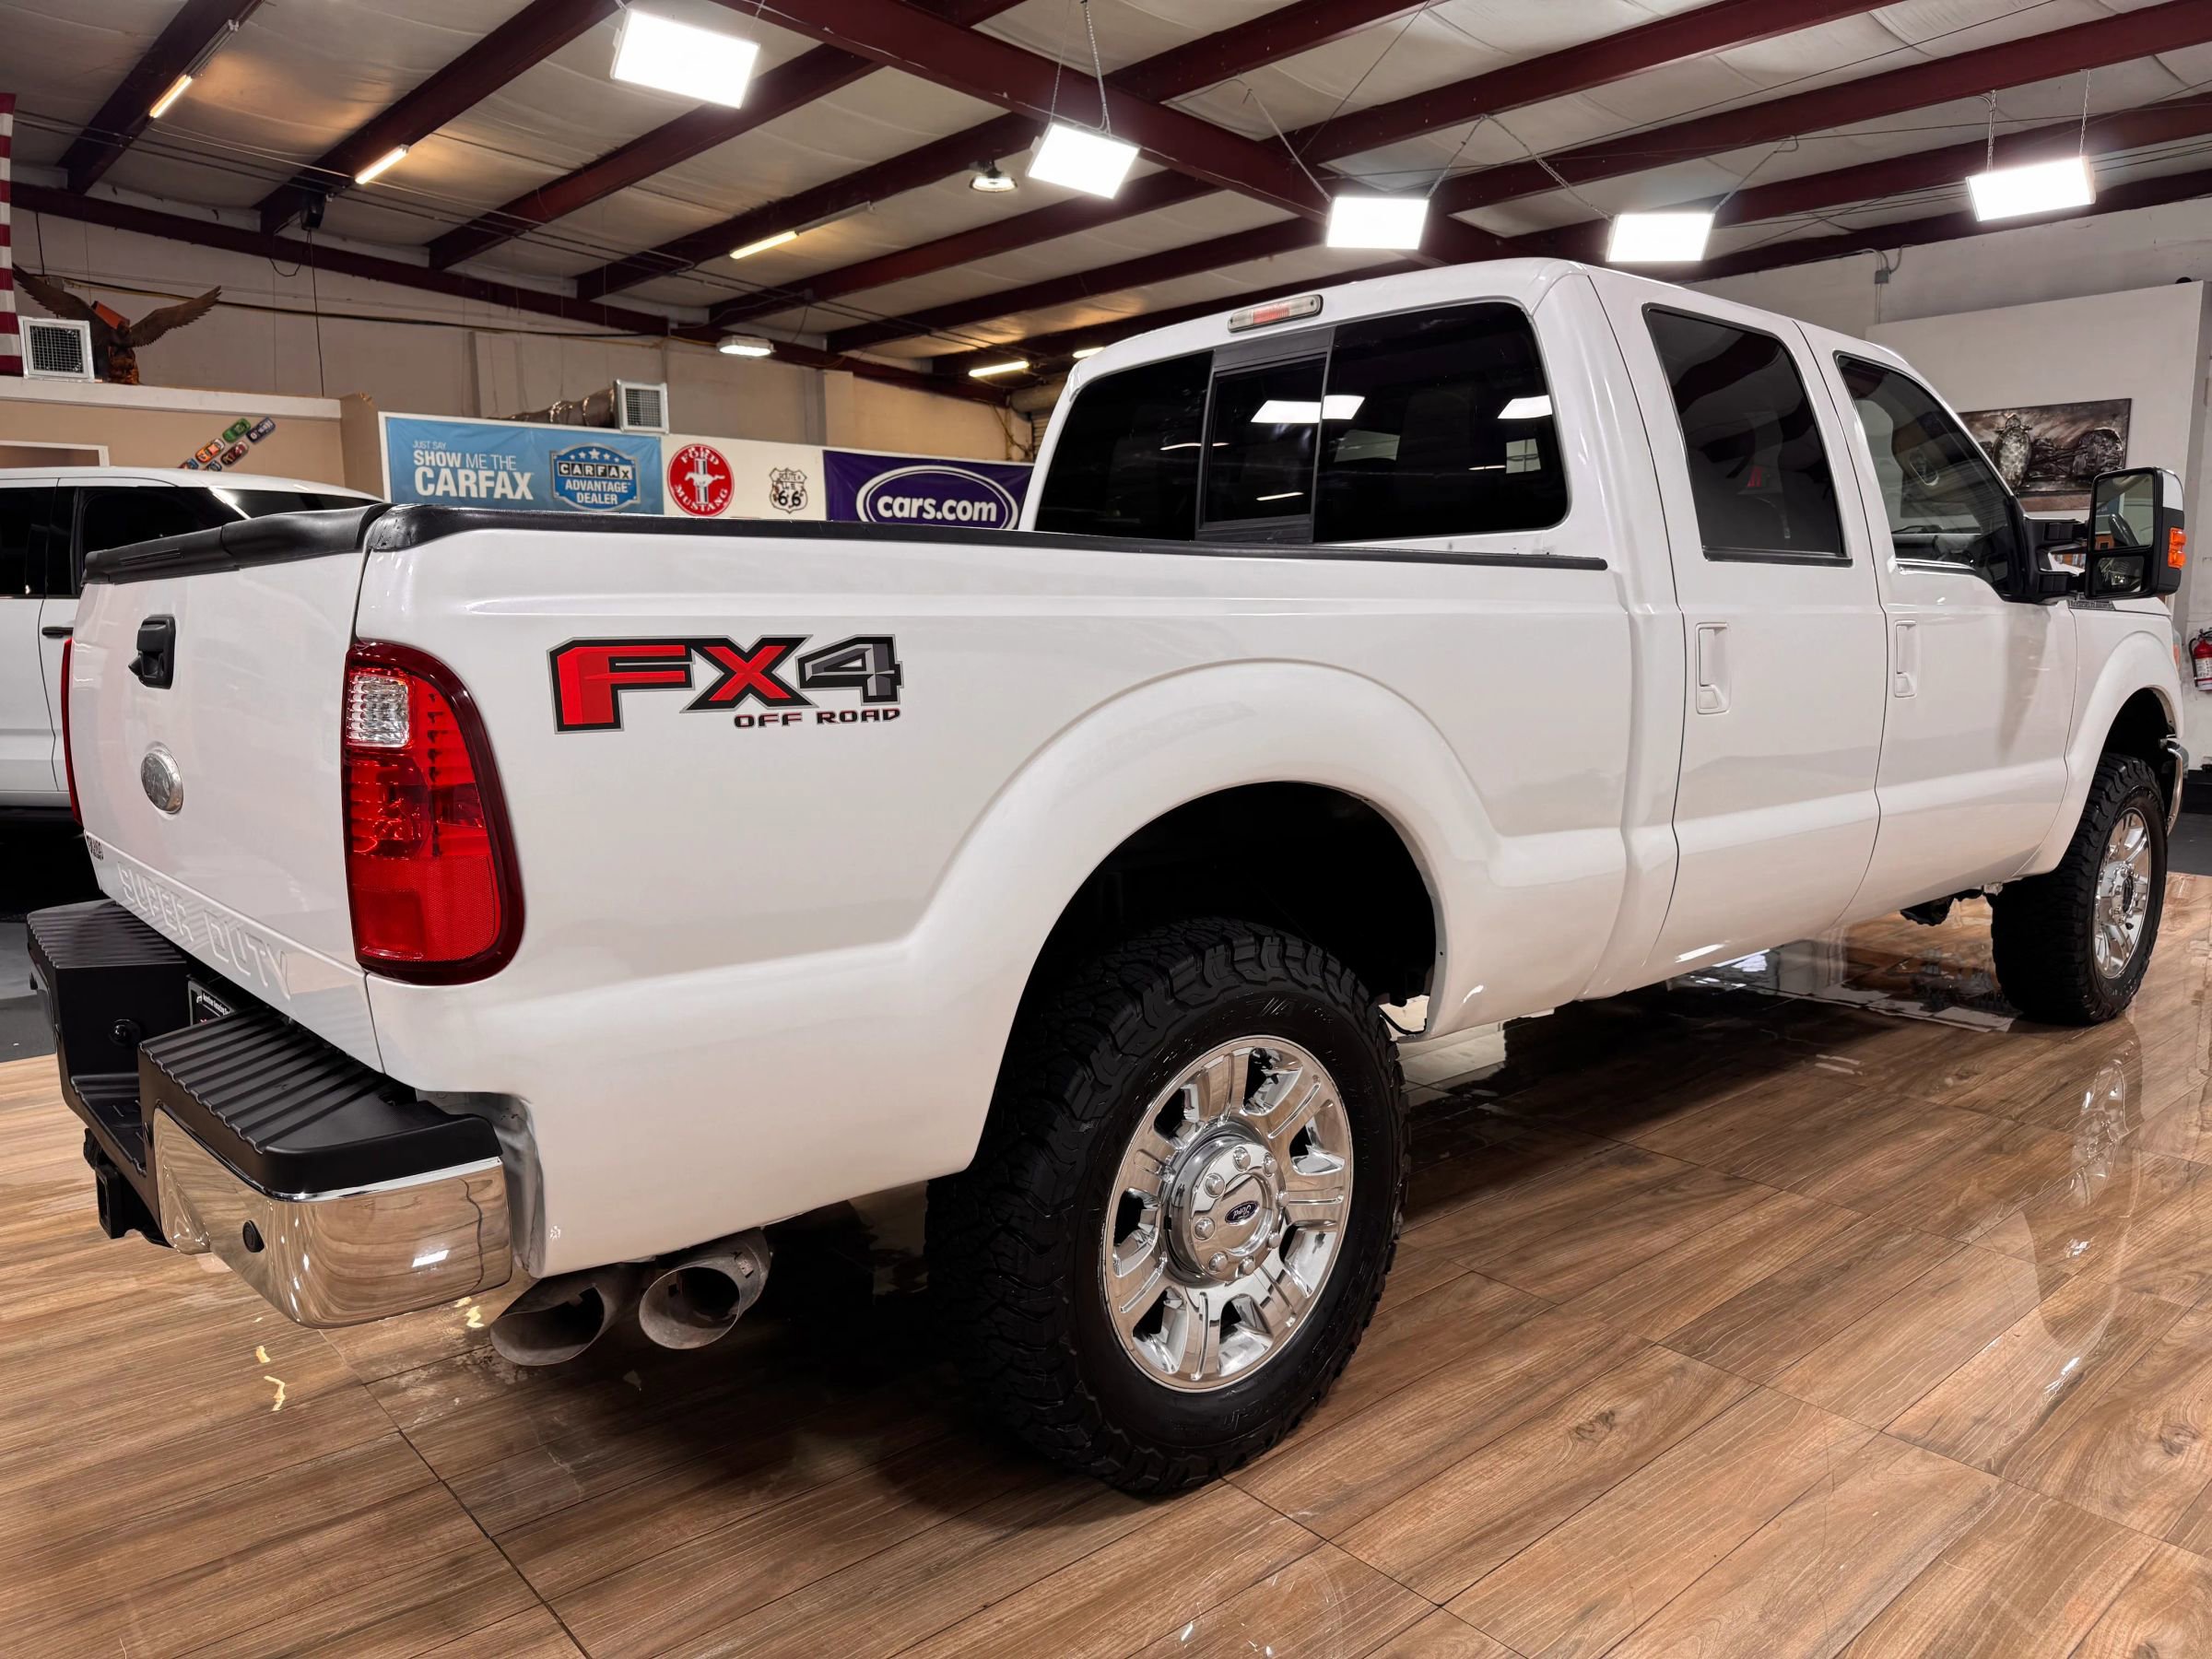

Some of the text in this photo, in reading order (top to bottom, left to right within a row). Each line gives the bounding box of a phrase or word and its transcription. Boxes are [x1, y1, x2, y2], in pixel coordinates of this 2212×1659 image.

[412, 441, 447, 451] JUST SAY
[680, 447, 720, 465] FORD
[413, 449, 518, 471] SHOW ME THE
[559, 463, 629, 479] CARFAX
[414, 465, 535, 500] CARFAX
[565, 479, 629, 493] ADVANTAGE
[576, 492, 618, 505] DEALER
[674, 484, 728, 512] MUSTANG
[778, 489, 802, 507] 66
[877, 493, 998, 523] cars.com
[547, 634, 904, 735] FX4
[734, 708, 902, 729] OFF ROAD
[117, 860, 291, 1002] SUPER DUTY
